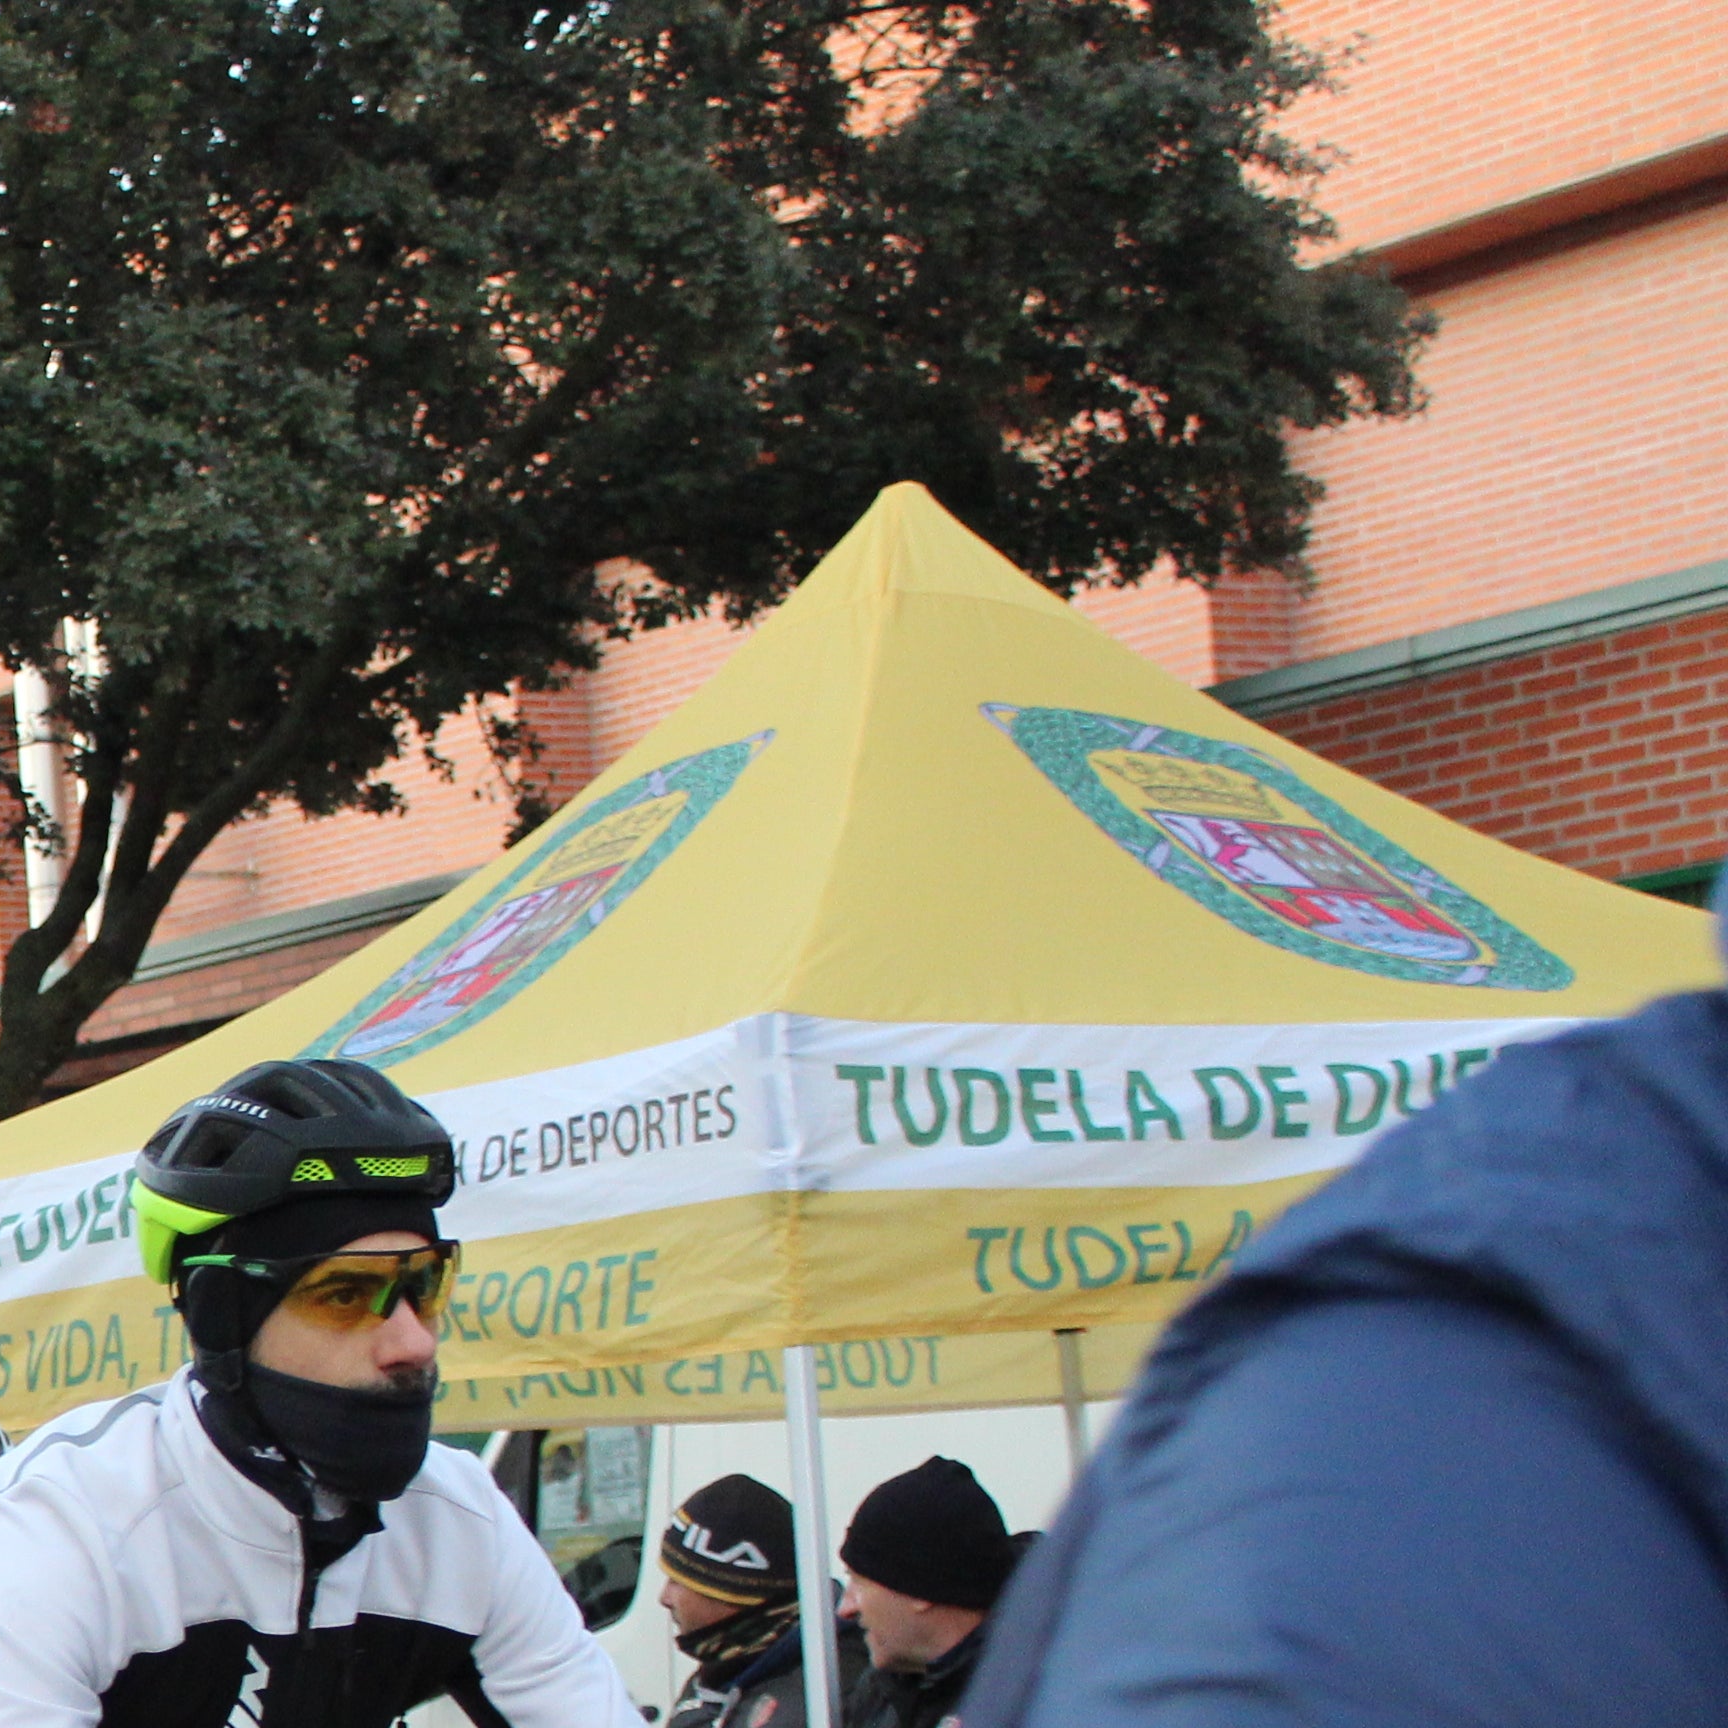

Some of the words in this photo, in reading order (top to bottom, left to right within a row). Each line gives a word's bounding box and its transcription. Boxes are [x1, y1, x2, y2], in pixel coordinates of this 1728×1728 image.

[479, 1128, 530, 1183] DE
[538, 1085, 736, 1173] DEPORTES
[836, 1060, 1184, 1148] TUDELA
[1194, 1064, 1310, 1141] DE
[966, 1208, 1254, 1294] TUDELA
[27, 1313, 139, 1390] VIDA,
